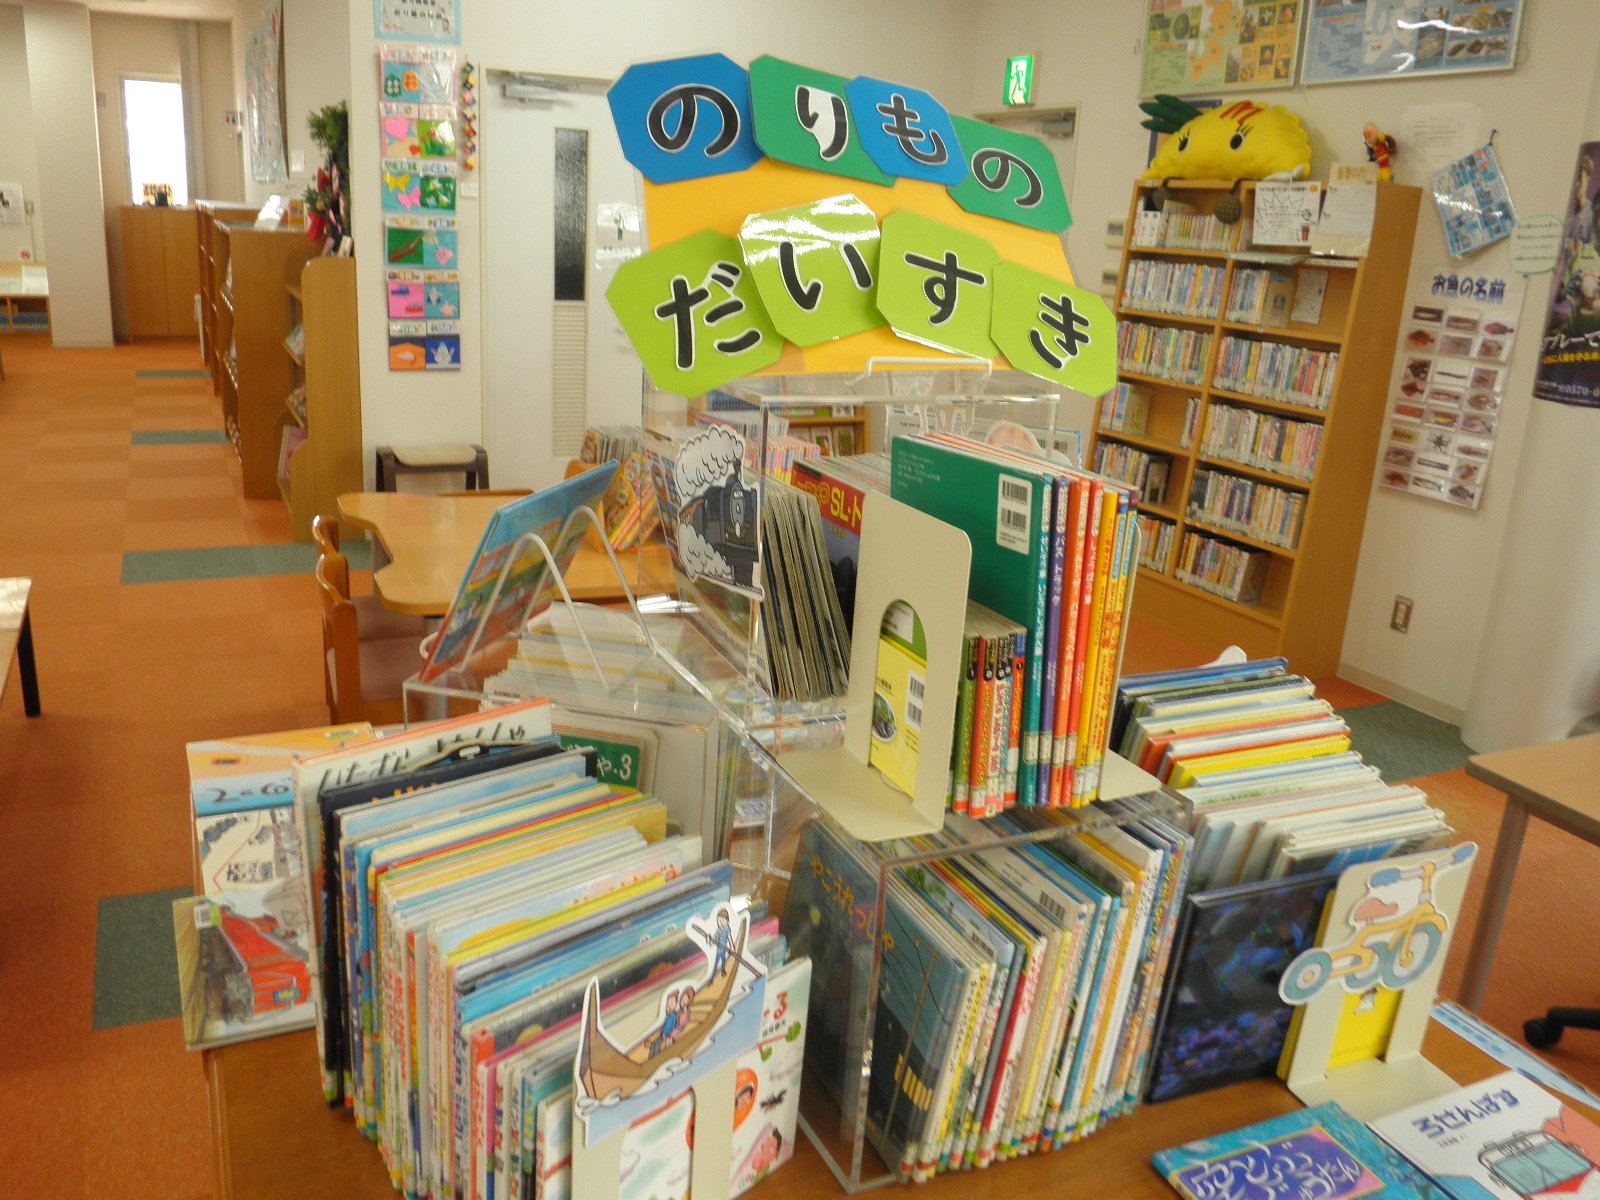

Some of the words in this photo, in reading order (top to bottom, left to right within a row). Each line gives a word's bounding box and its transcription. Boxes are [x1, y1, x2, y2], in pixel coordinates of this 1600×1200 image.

[646, 83, 1044, 208] のりもの
[654, 238, 1092, 370] だいすき
[1430, 271, 1507, 304] お魚の名前
[1410, 1087, 1520, 1139] ろせんばす
